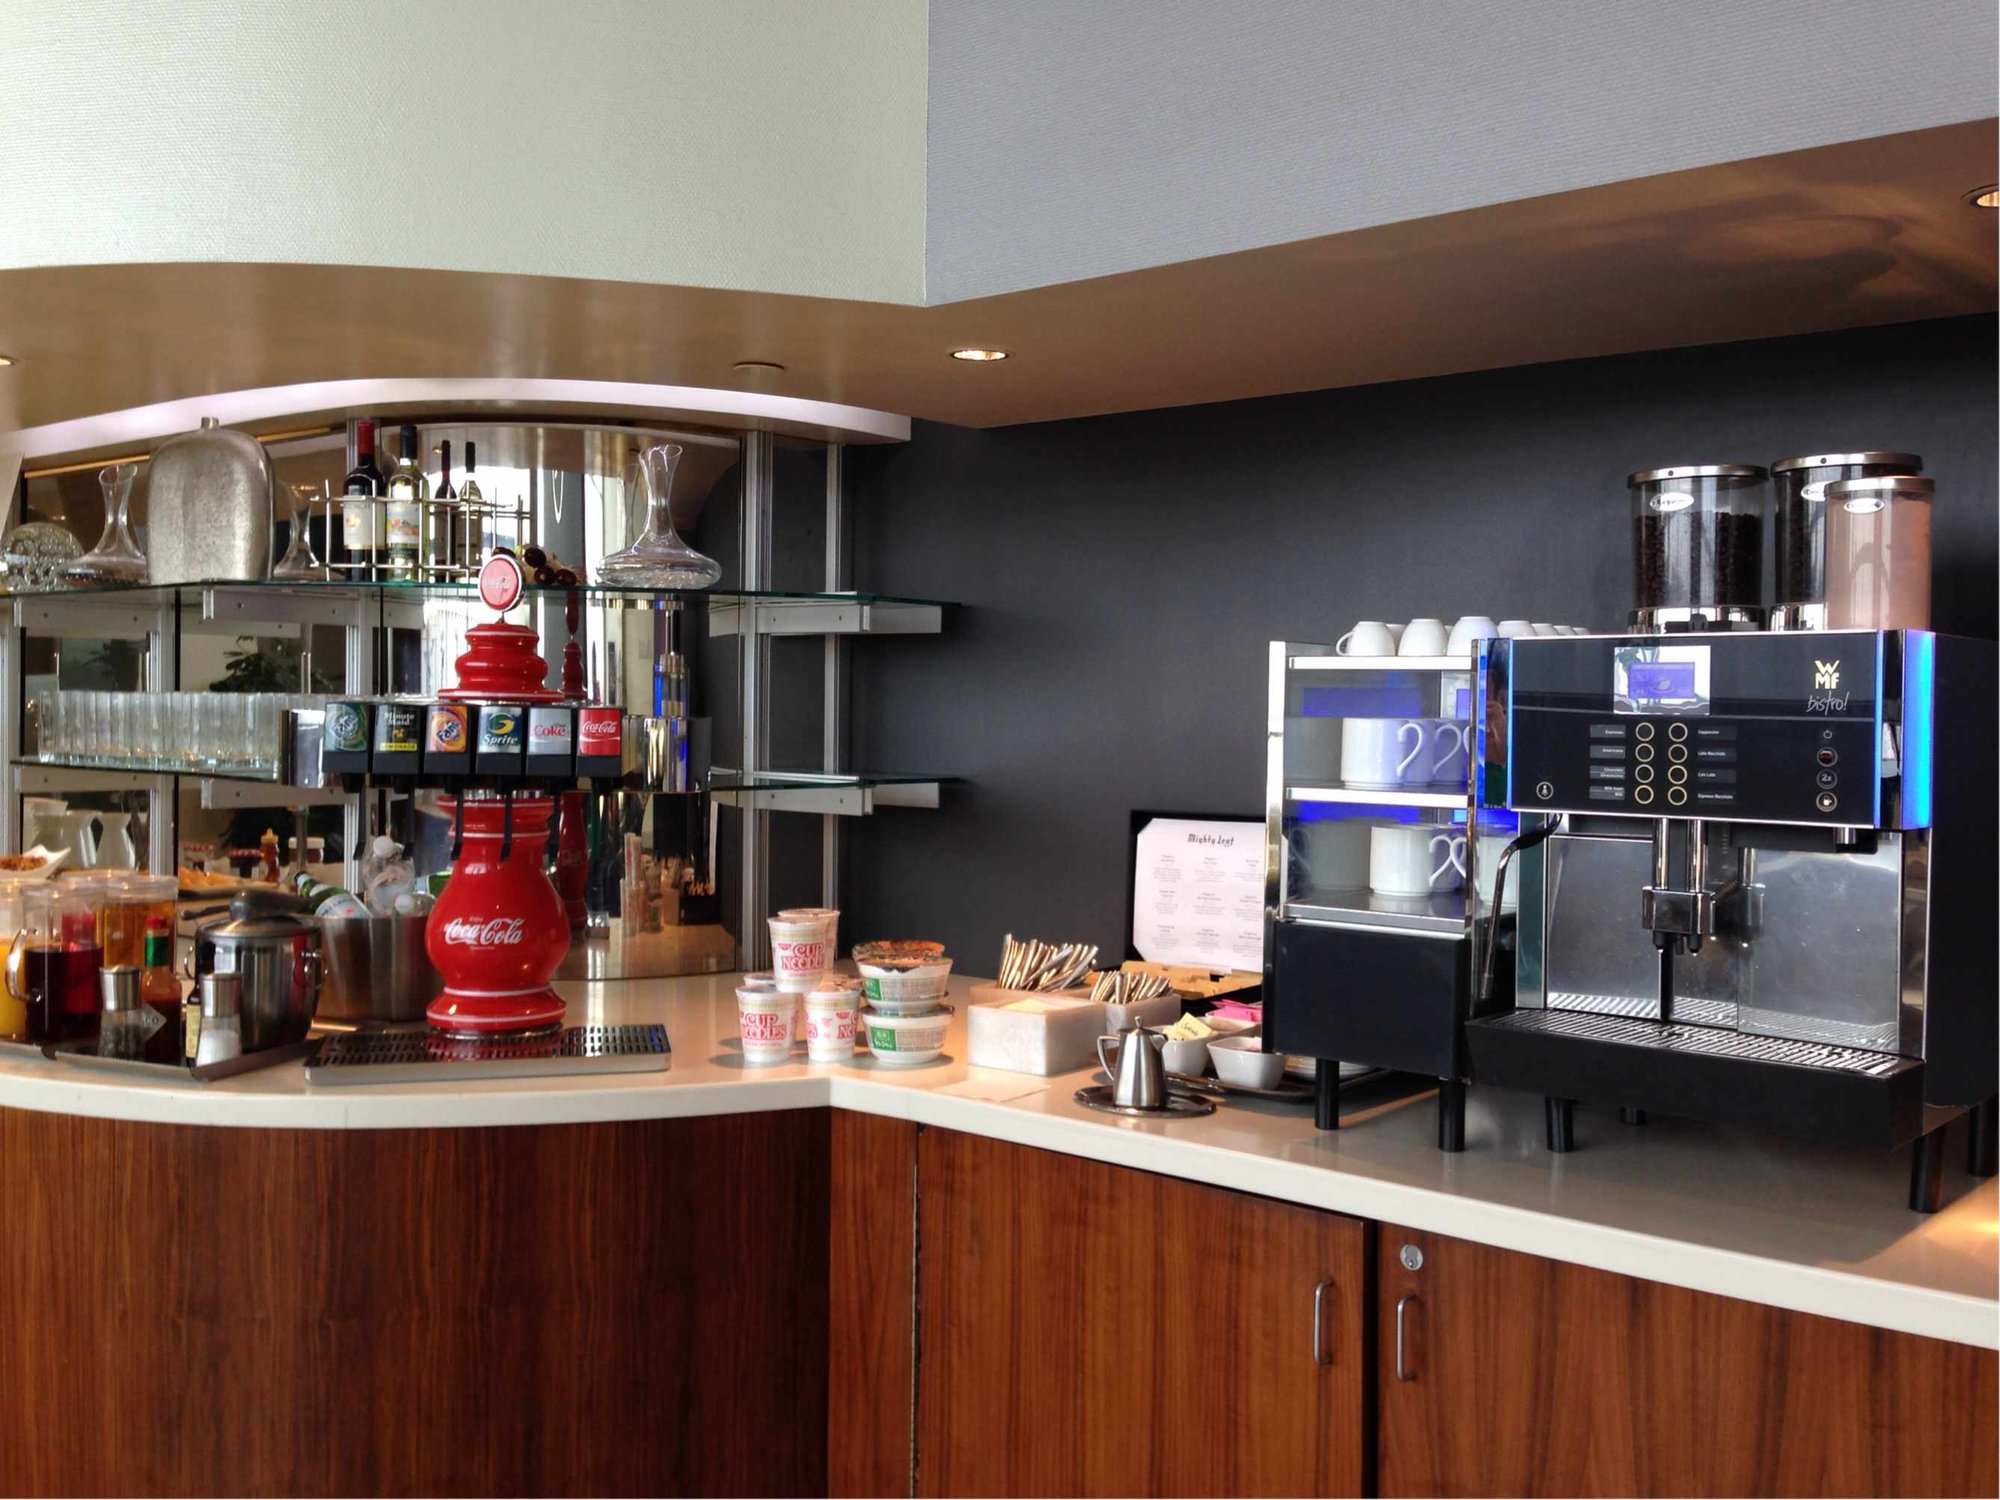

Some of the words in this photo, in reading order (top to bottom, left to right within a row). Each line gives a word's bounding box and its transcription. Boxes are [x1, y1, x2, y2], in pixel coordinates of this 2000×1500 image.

[1806, 691, 1850, 716] bistro!
[534, 724, 566, 737] Coke
[484, 734, 518, 746] Sprite
[1821, 773, 1833, 782] 2x
[1188, 833, 1216, 846] Mighty
[444, 917, 525, 945] Coca-Cola
[792, 942, 825, 957] CUP
[745, 1012, 779, 1027] CUP
[742, 1023, 787, 1041] OODLES
